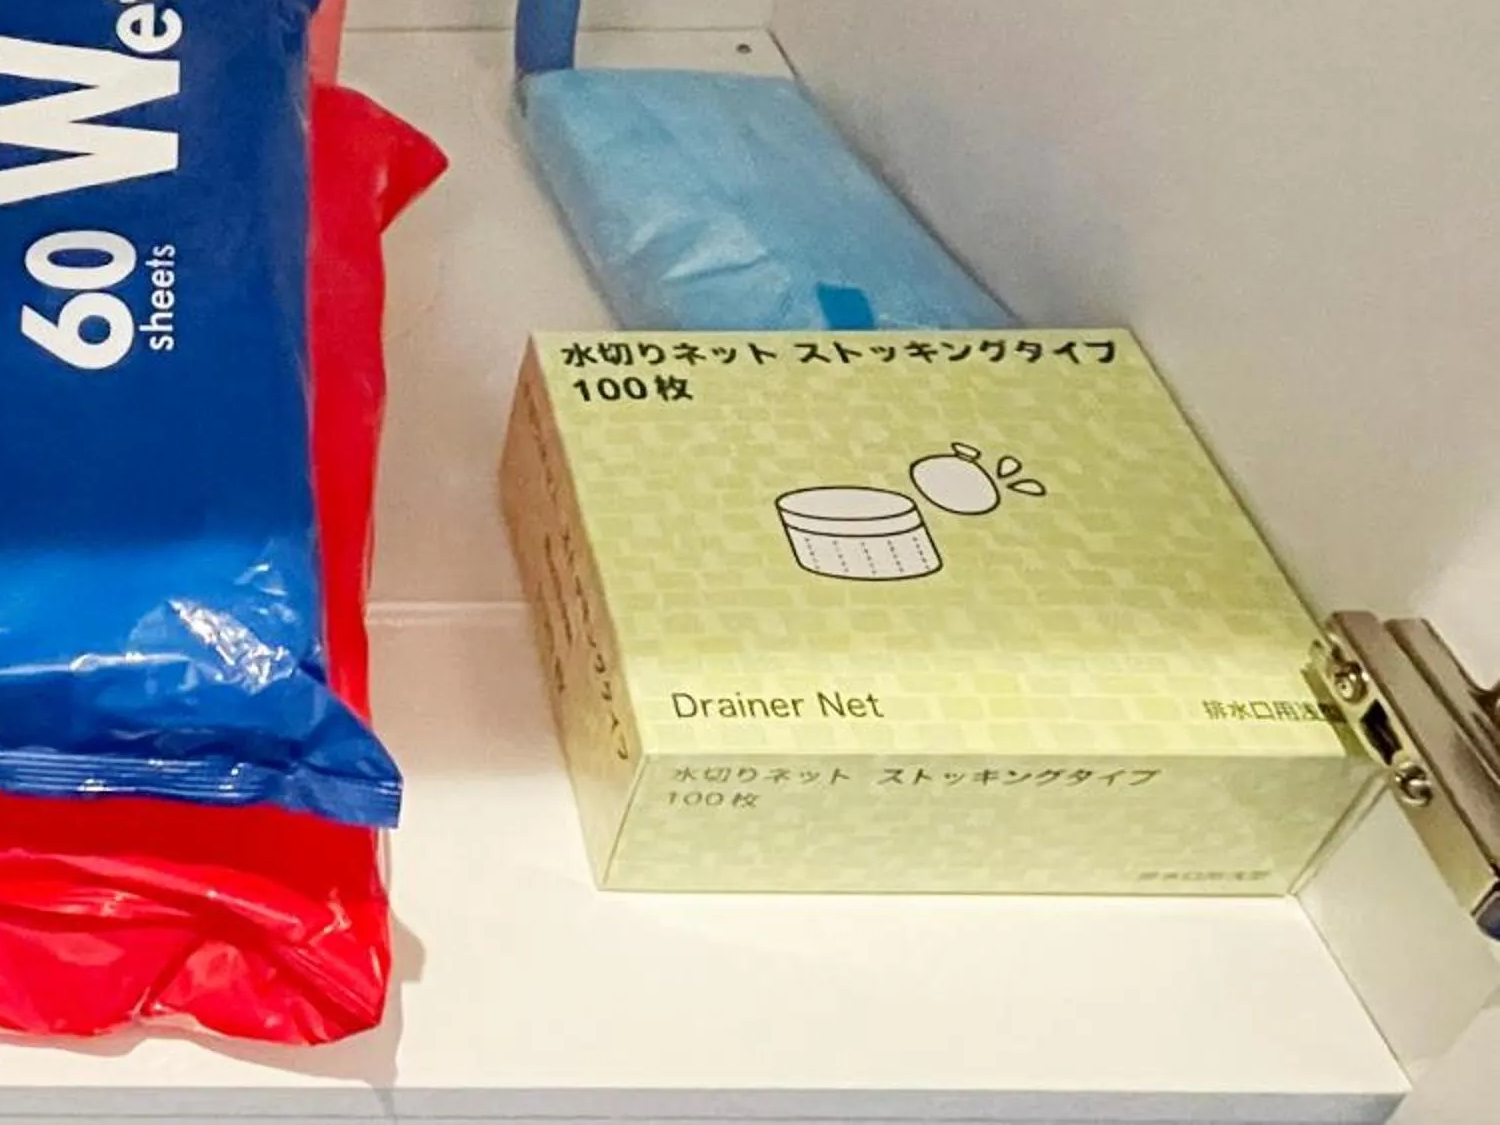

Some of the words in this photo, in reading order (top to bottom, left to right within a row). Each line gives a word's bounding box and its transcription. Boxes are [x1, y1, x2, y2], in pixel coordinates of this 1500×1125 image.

[20, 230, 138, 371] 60
[139, 243, 176, 352] sheets
[561, 341, 778, 368] 水切りネット
[798, 339, 1118, 365] ストッキングタイプ
[573, 374, 695, 403] 100枚
[671, 691, 805, 719] Drainer
[816, 691, 885, 719] Net
[673, 766, 851, 786] 水切りネット
[876, 767, 1163, 787] ストッキングタイプ
[667, 791, 761, 809] 100枚
